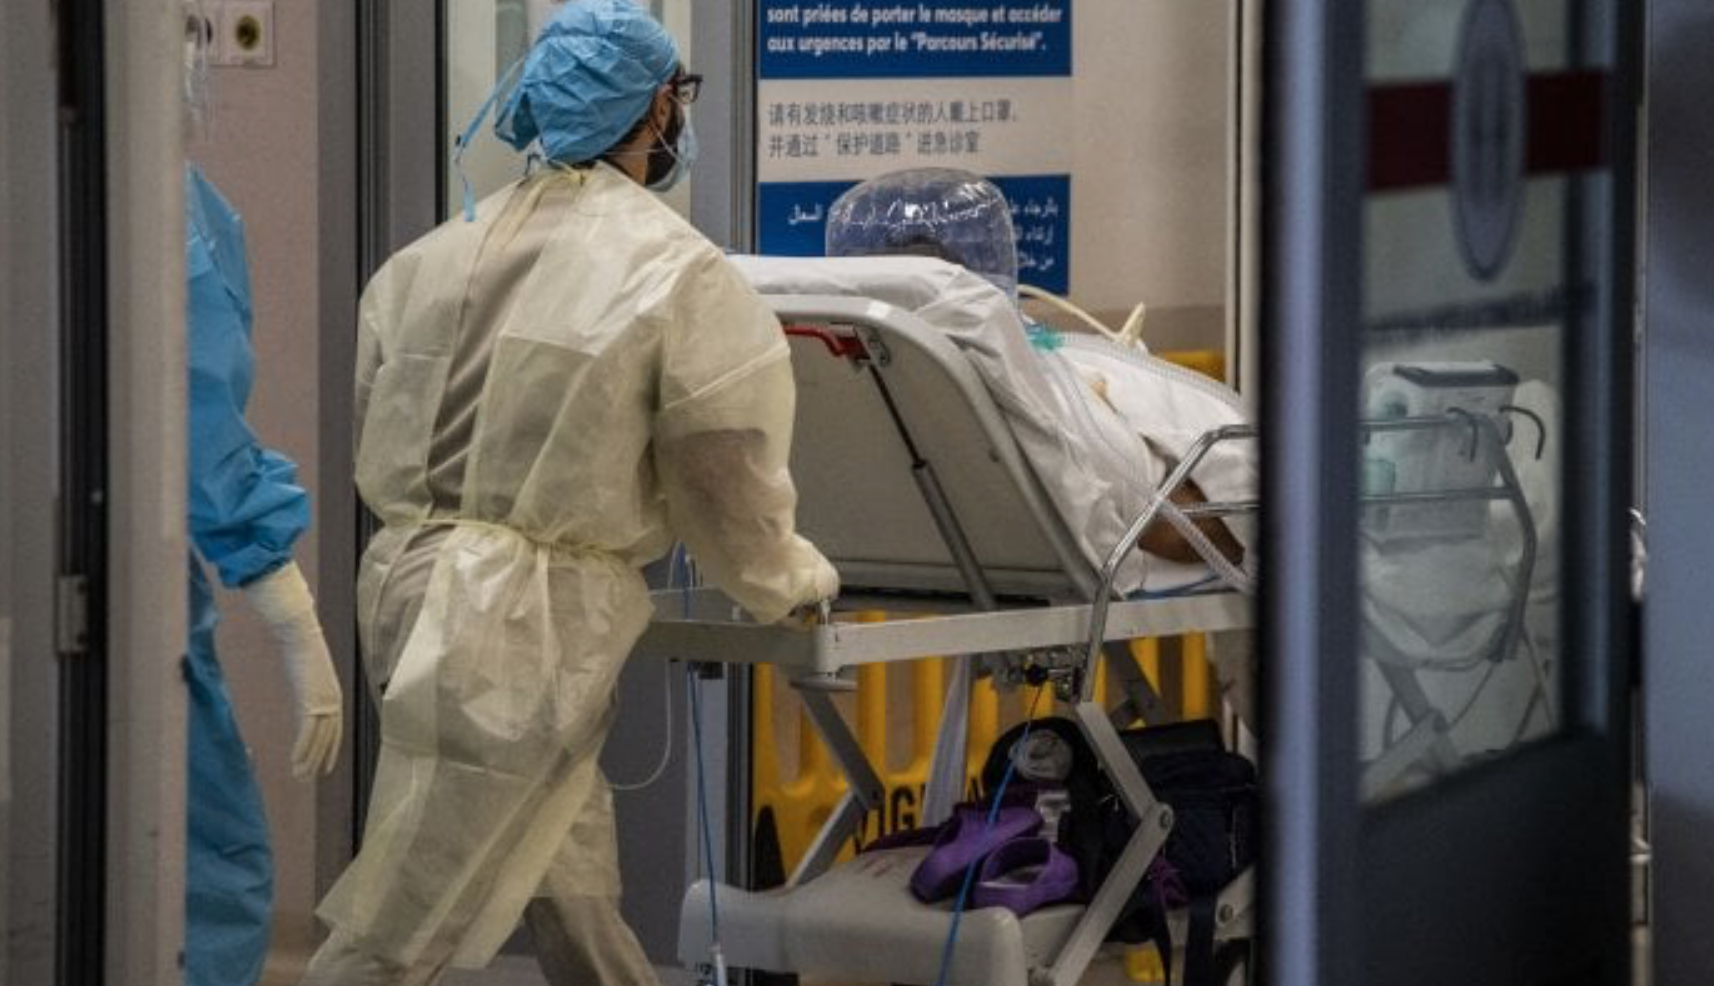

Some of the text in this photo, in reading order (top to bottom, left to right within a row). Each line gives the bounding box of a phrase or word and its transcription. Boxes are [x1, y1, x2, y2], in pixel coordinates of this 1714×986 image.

[767, 3, 1062, 28] sont priées de porter le masque et accéder
[767, 37, 795, 51] aux
[798, 37, 863, 56] urgences
[866, 37, 891, 55] par
[895, 31, 908, 50] le
